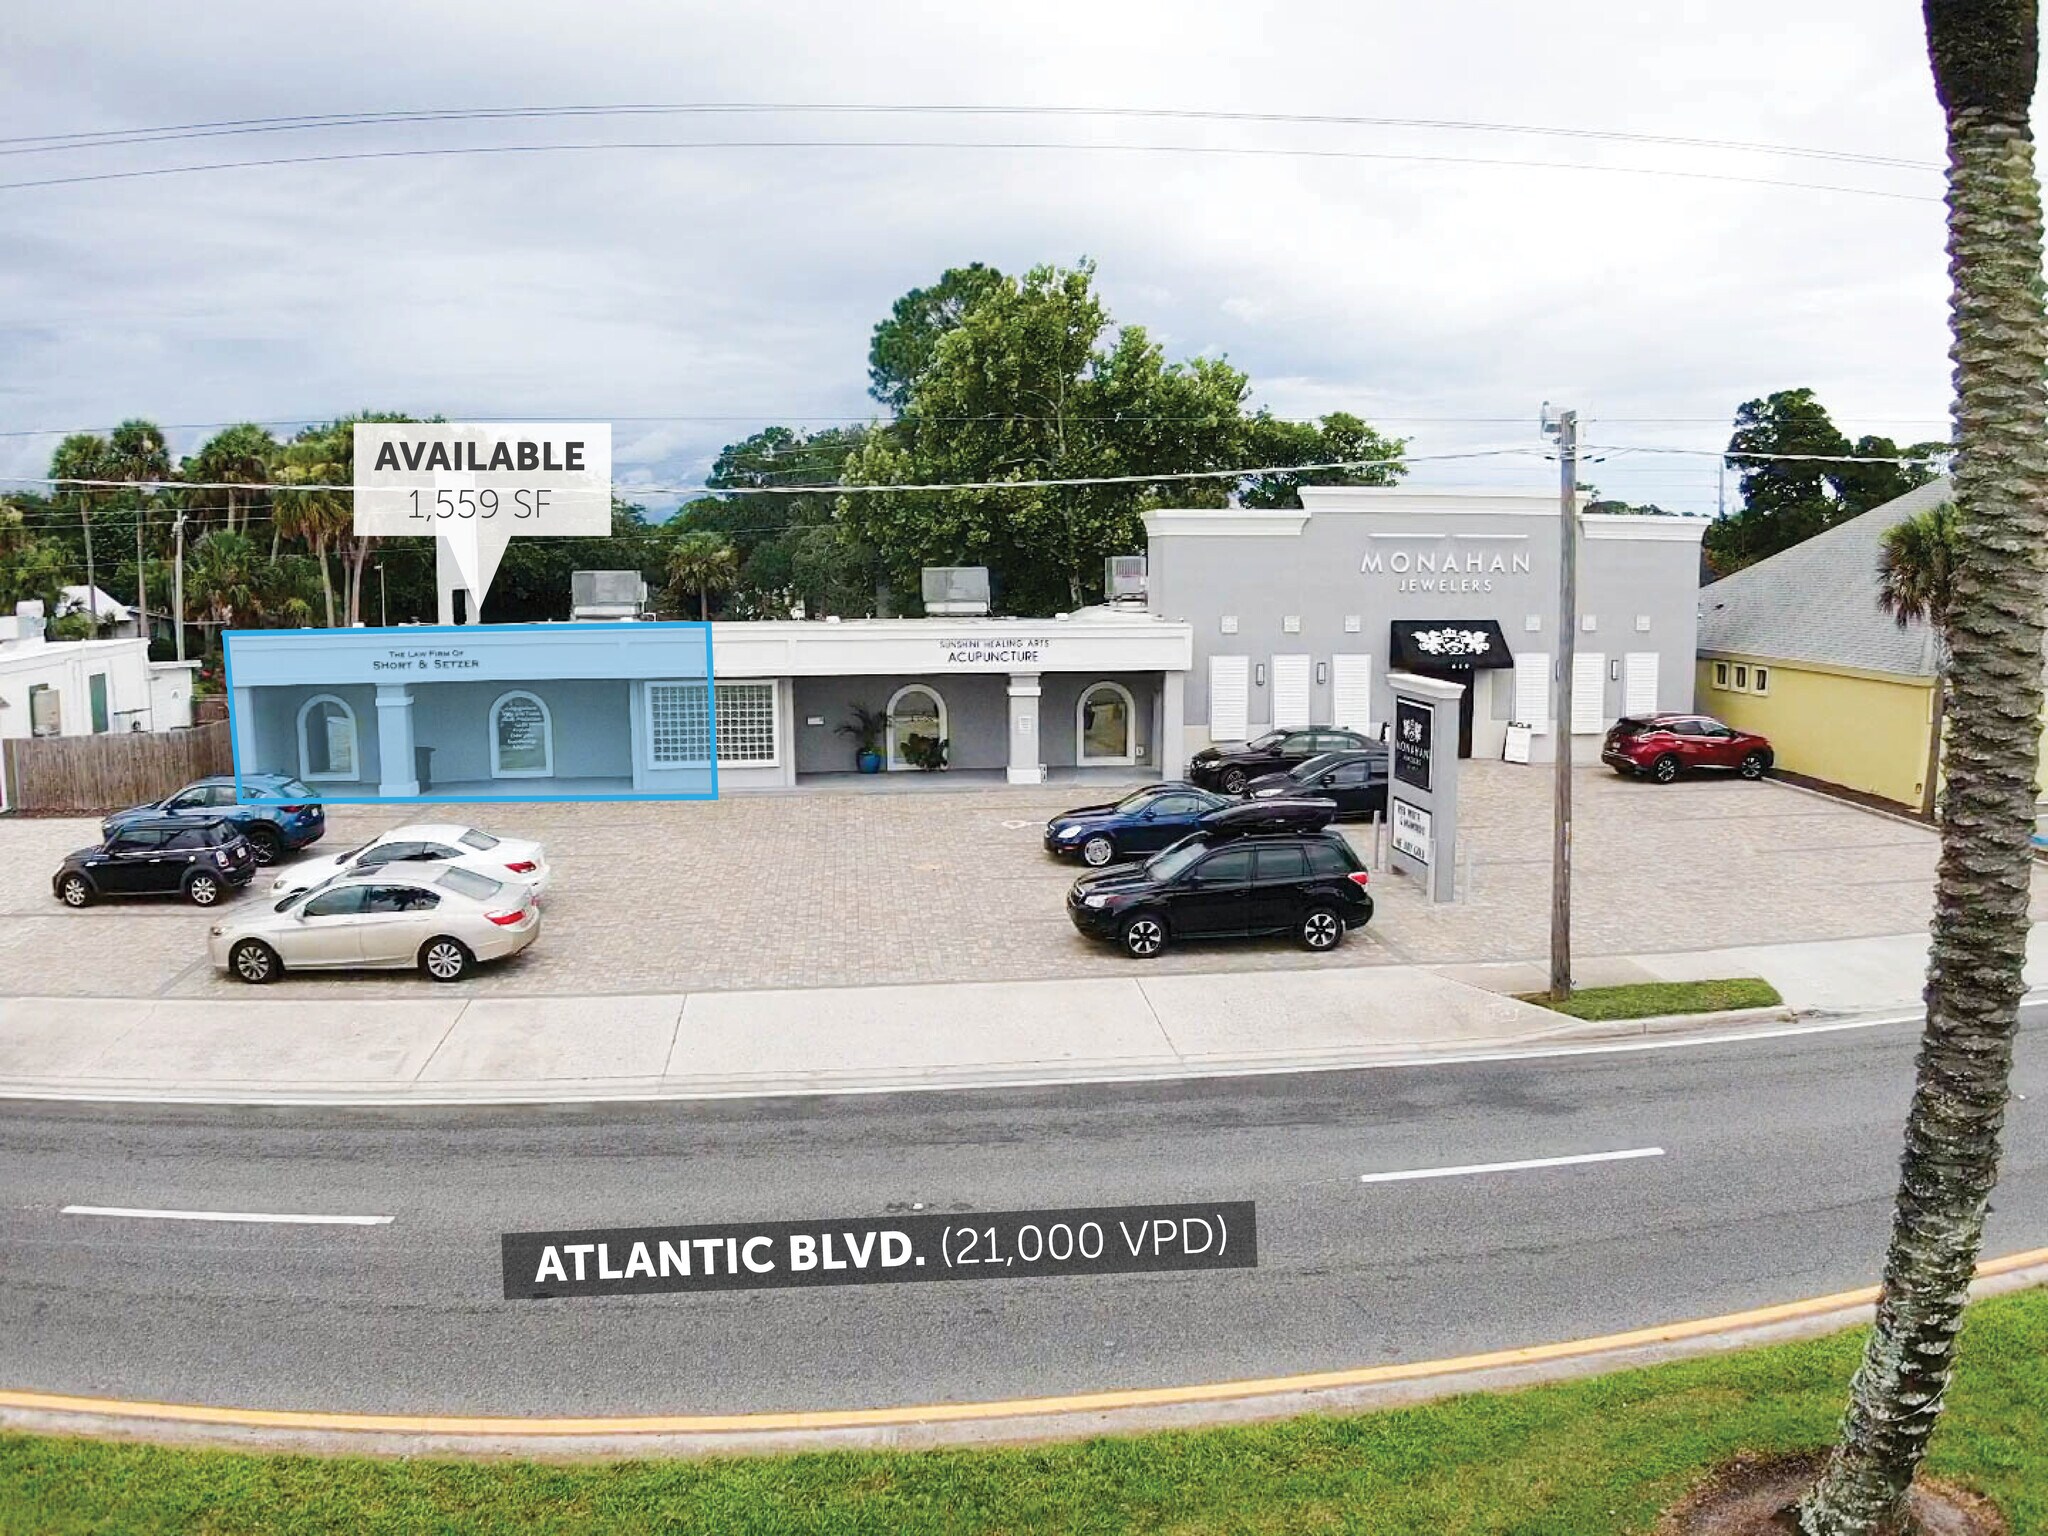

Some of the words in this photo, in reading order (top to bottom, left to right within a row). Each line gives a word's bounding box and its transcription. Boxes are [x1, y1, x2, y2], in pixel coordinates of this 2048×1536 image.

[1360, 551, 1531, 574] MONAHAN
[1399, 578, 1492, 594] JEWELERS
[1027, 639, 1050, 648] ARTS
[948, 650, 1039, 663] ACUPUNCTURE
[373, 660, 413, 671] SHORT
[434, 659, 479, 669] SETZER
